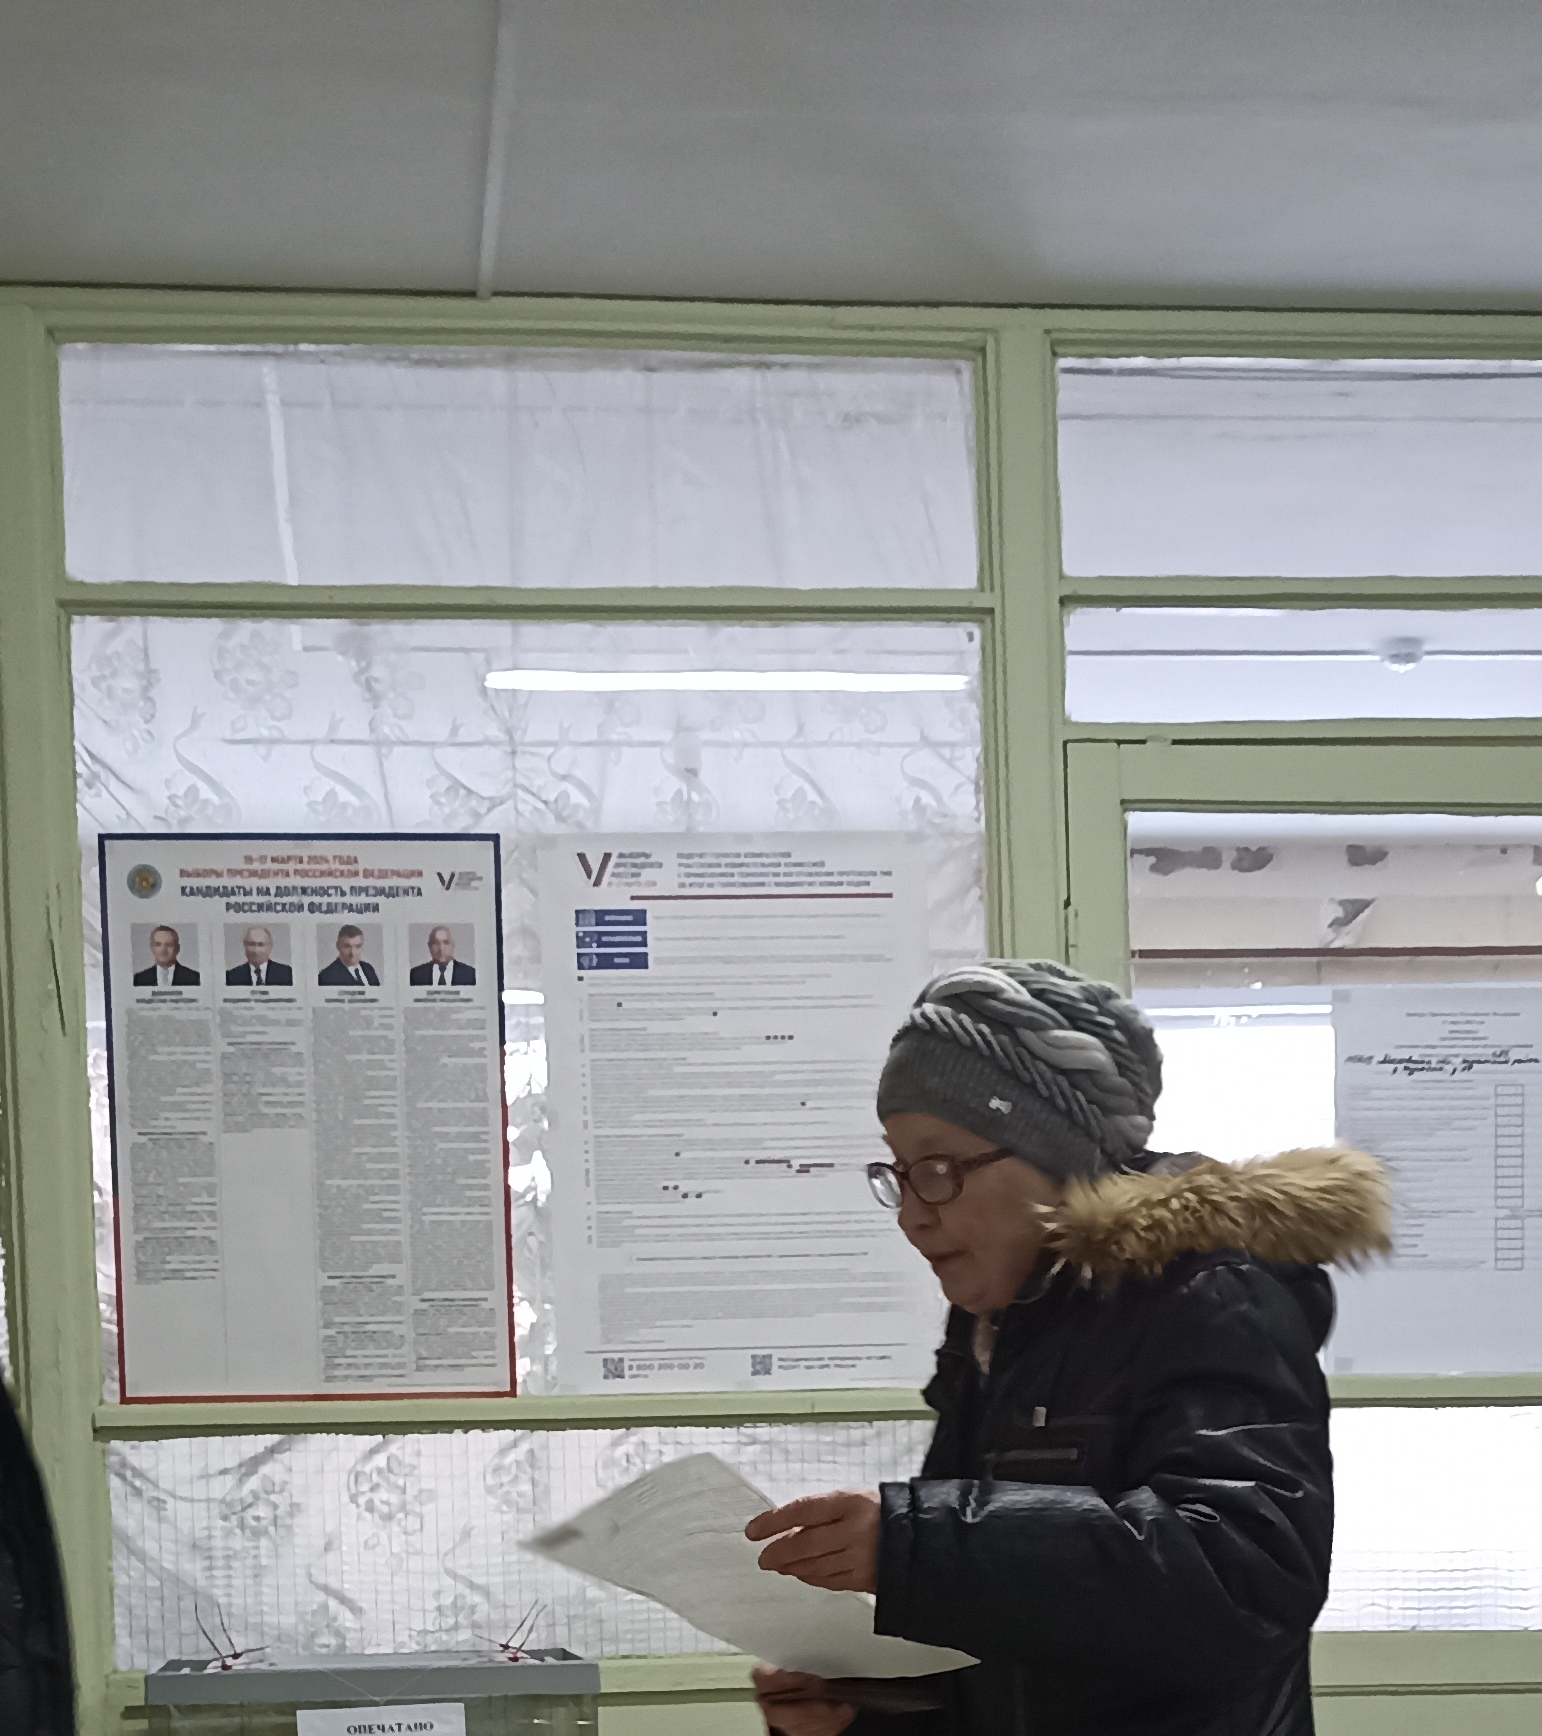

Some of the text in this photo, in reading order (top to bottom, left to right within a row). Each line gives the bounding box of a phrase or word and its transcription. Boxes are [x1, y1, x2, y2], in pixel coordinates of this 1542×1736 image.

[180, 885, 423, 899] КАНДИДАТЫ НА ДОЛЖНОСТЬ ПРЕЗИДЕНТА
[225, 900, 380, 915] РОССИЙСКОЙ ФЕДЕРАЦИИ
[346, 1721, 434, 1735] ОПЕЧАТАНО
